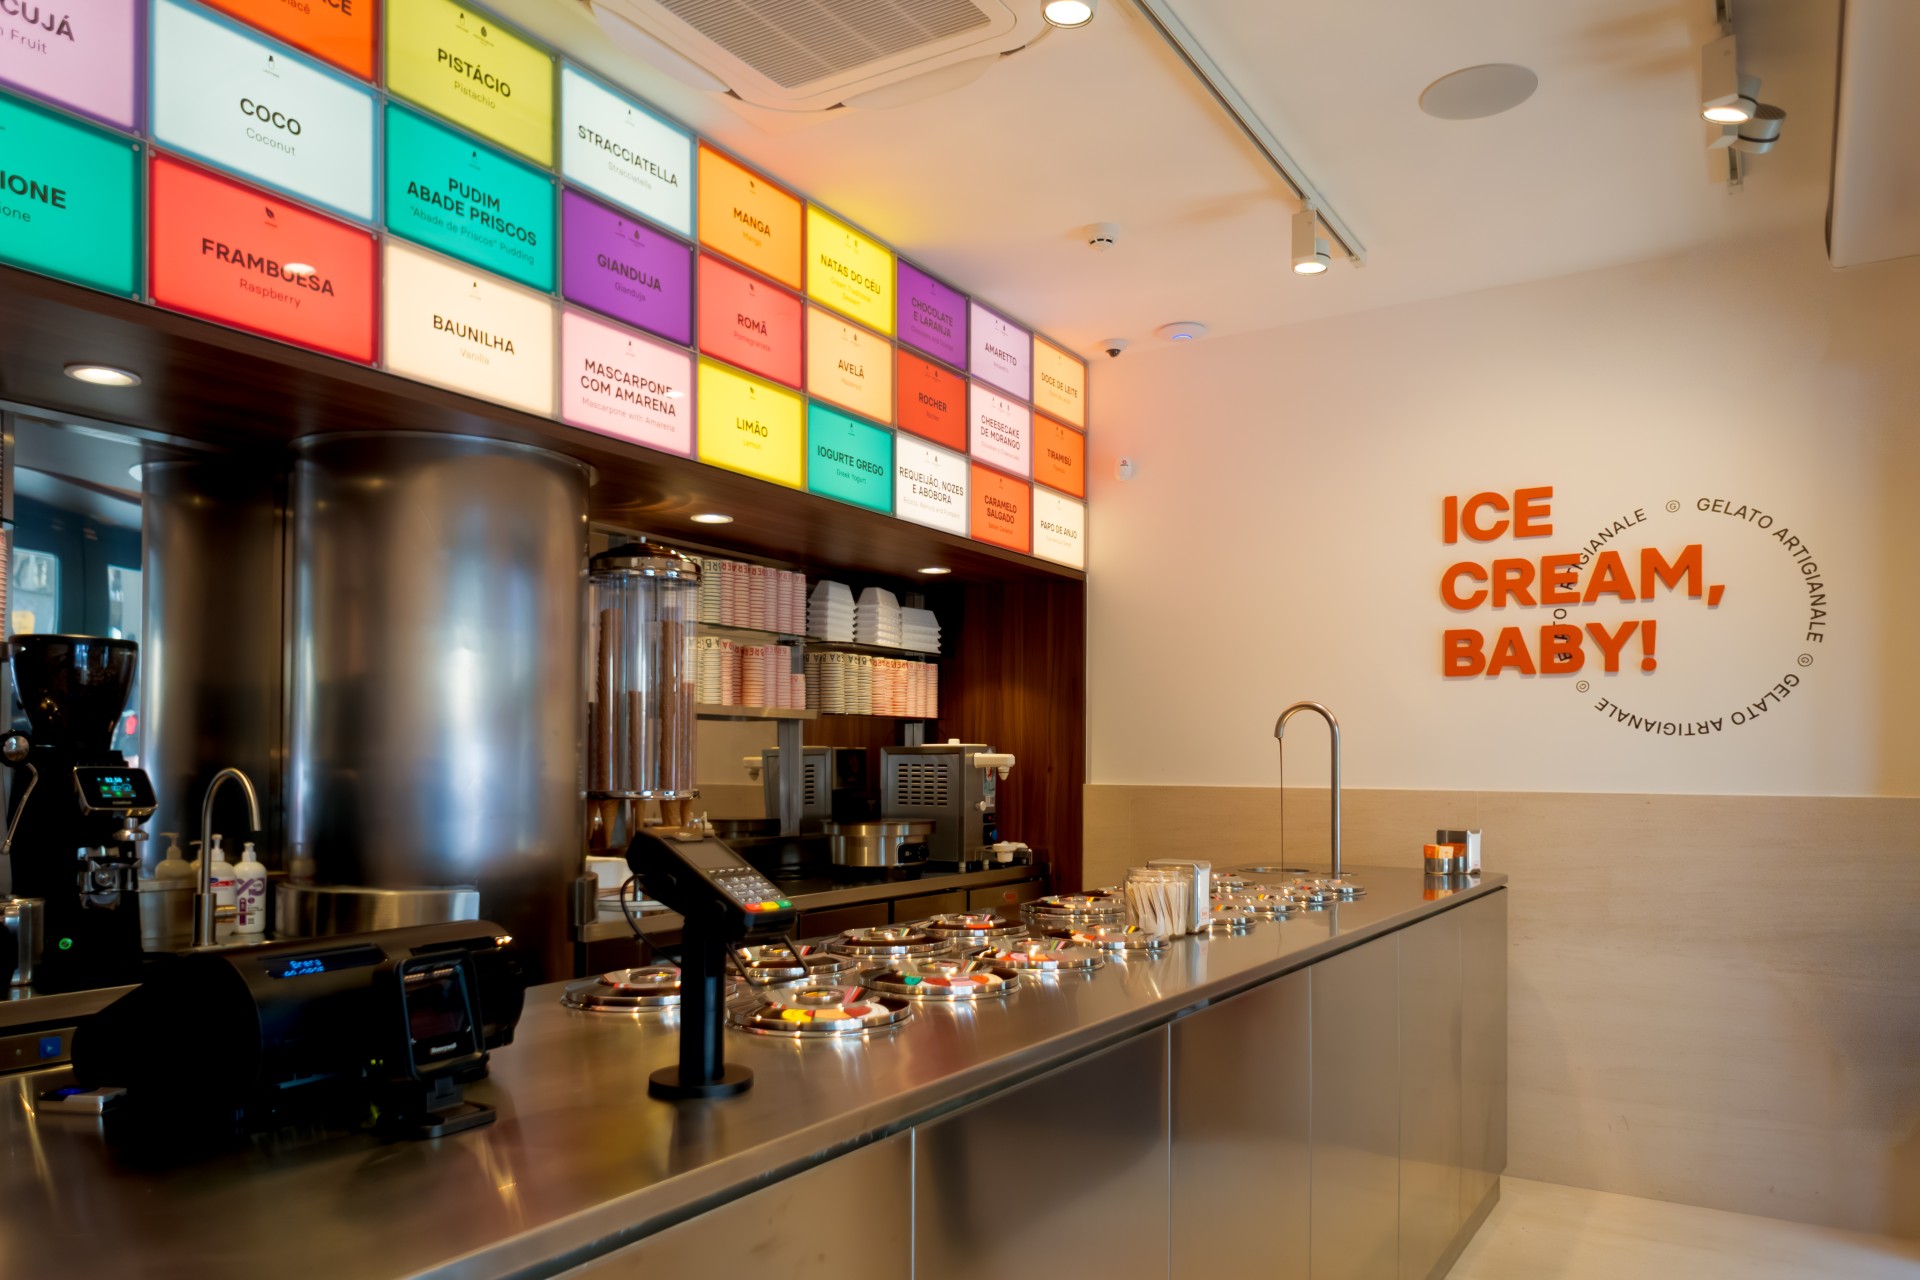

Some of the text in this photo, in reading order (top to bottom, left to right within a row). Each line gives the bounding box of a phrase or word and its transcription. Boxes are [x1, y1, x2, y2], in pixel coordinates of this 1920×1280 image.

[11, 28, 47, 54] Fruit
[437, 47, 511, 97] PISTÁCIO
[454, 80, 496, 109] Pistachio
[240, 97, 302, 136] COCO
[246, 127, 296, 156] Coconut
[578, 125, 678, 187] STRACCIATELLA
[449, 177, 501, 212] PUDIM
[407, 181, 537, 246] ABADE PRISCOS
[733, 207, 771, 237] MANGA
[446, 218, 458, 233] de
[500, 242, 535, 265] Pudding
[202, 237, 335, 297] FRAMBOESA
[597, 253, 662, 292] GIANDUJA
[820, 253, 881, 295] NATAS DO CÉU
[240, 278, 301, 308] Raspberry
[737, 313, 767, 336] ROMÃ
[911, 297, 953, 327] CHOCOLATE
[913, 311, 951, 338] E LARANJA
[433, 314, 515, 355] BAUNILHA
[985, 342, 1017, 366] AMARETTO
[585, 358, 673, 399] MASCARPONE
[838, 359, 865, 380] AVELÃ
[581, 375, 676, 417] COM AMARENA
[918, 392, 947, 412] ROCHER
[736, 416, 769, 438] LIMÃO
[980, 426, 1020, 450] DE MORANGO
[981, 414, 1019, 439] CHEESECAKE
[817, 445, 884, 477] IOGURTE GREGO
[912, 483, 917, 494] E
[942, 481, 964, 496] NOZES
[984, 494, 1018, 514] CARAMELO
[987, 507, 1015, 525] SALGADO
[1443, 486, 1553, 544] ICE
[1040, 520, 1054, 532] PAPO
[1441, 544, 1725, 611] CREAM,
[1697, 498, 1827, 643] GELATO ARTIGIANALE
[1443, 620, 1657, 677] BABY!
[1594, 673, 1800, 736] GELATO ARTIGIANALE
